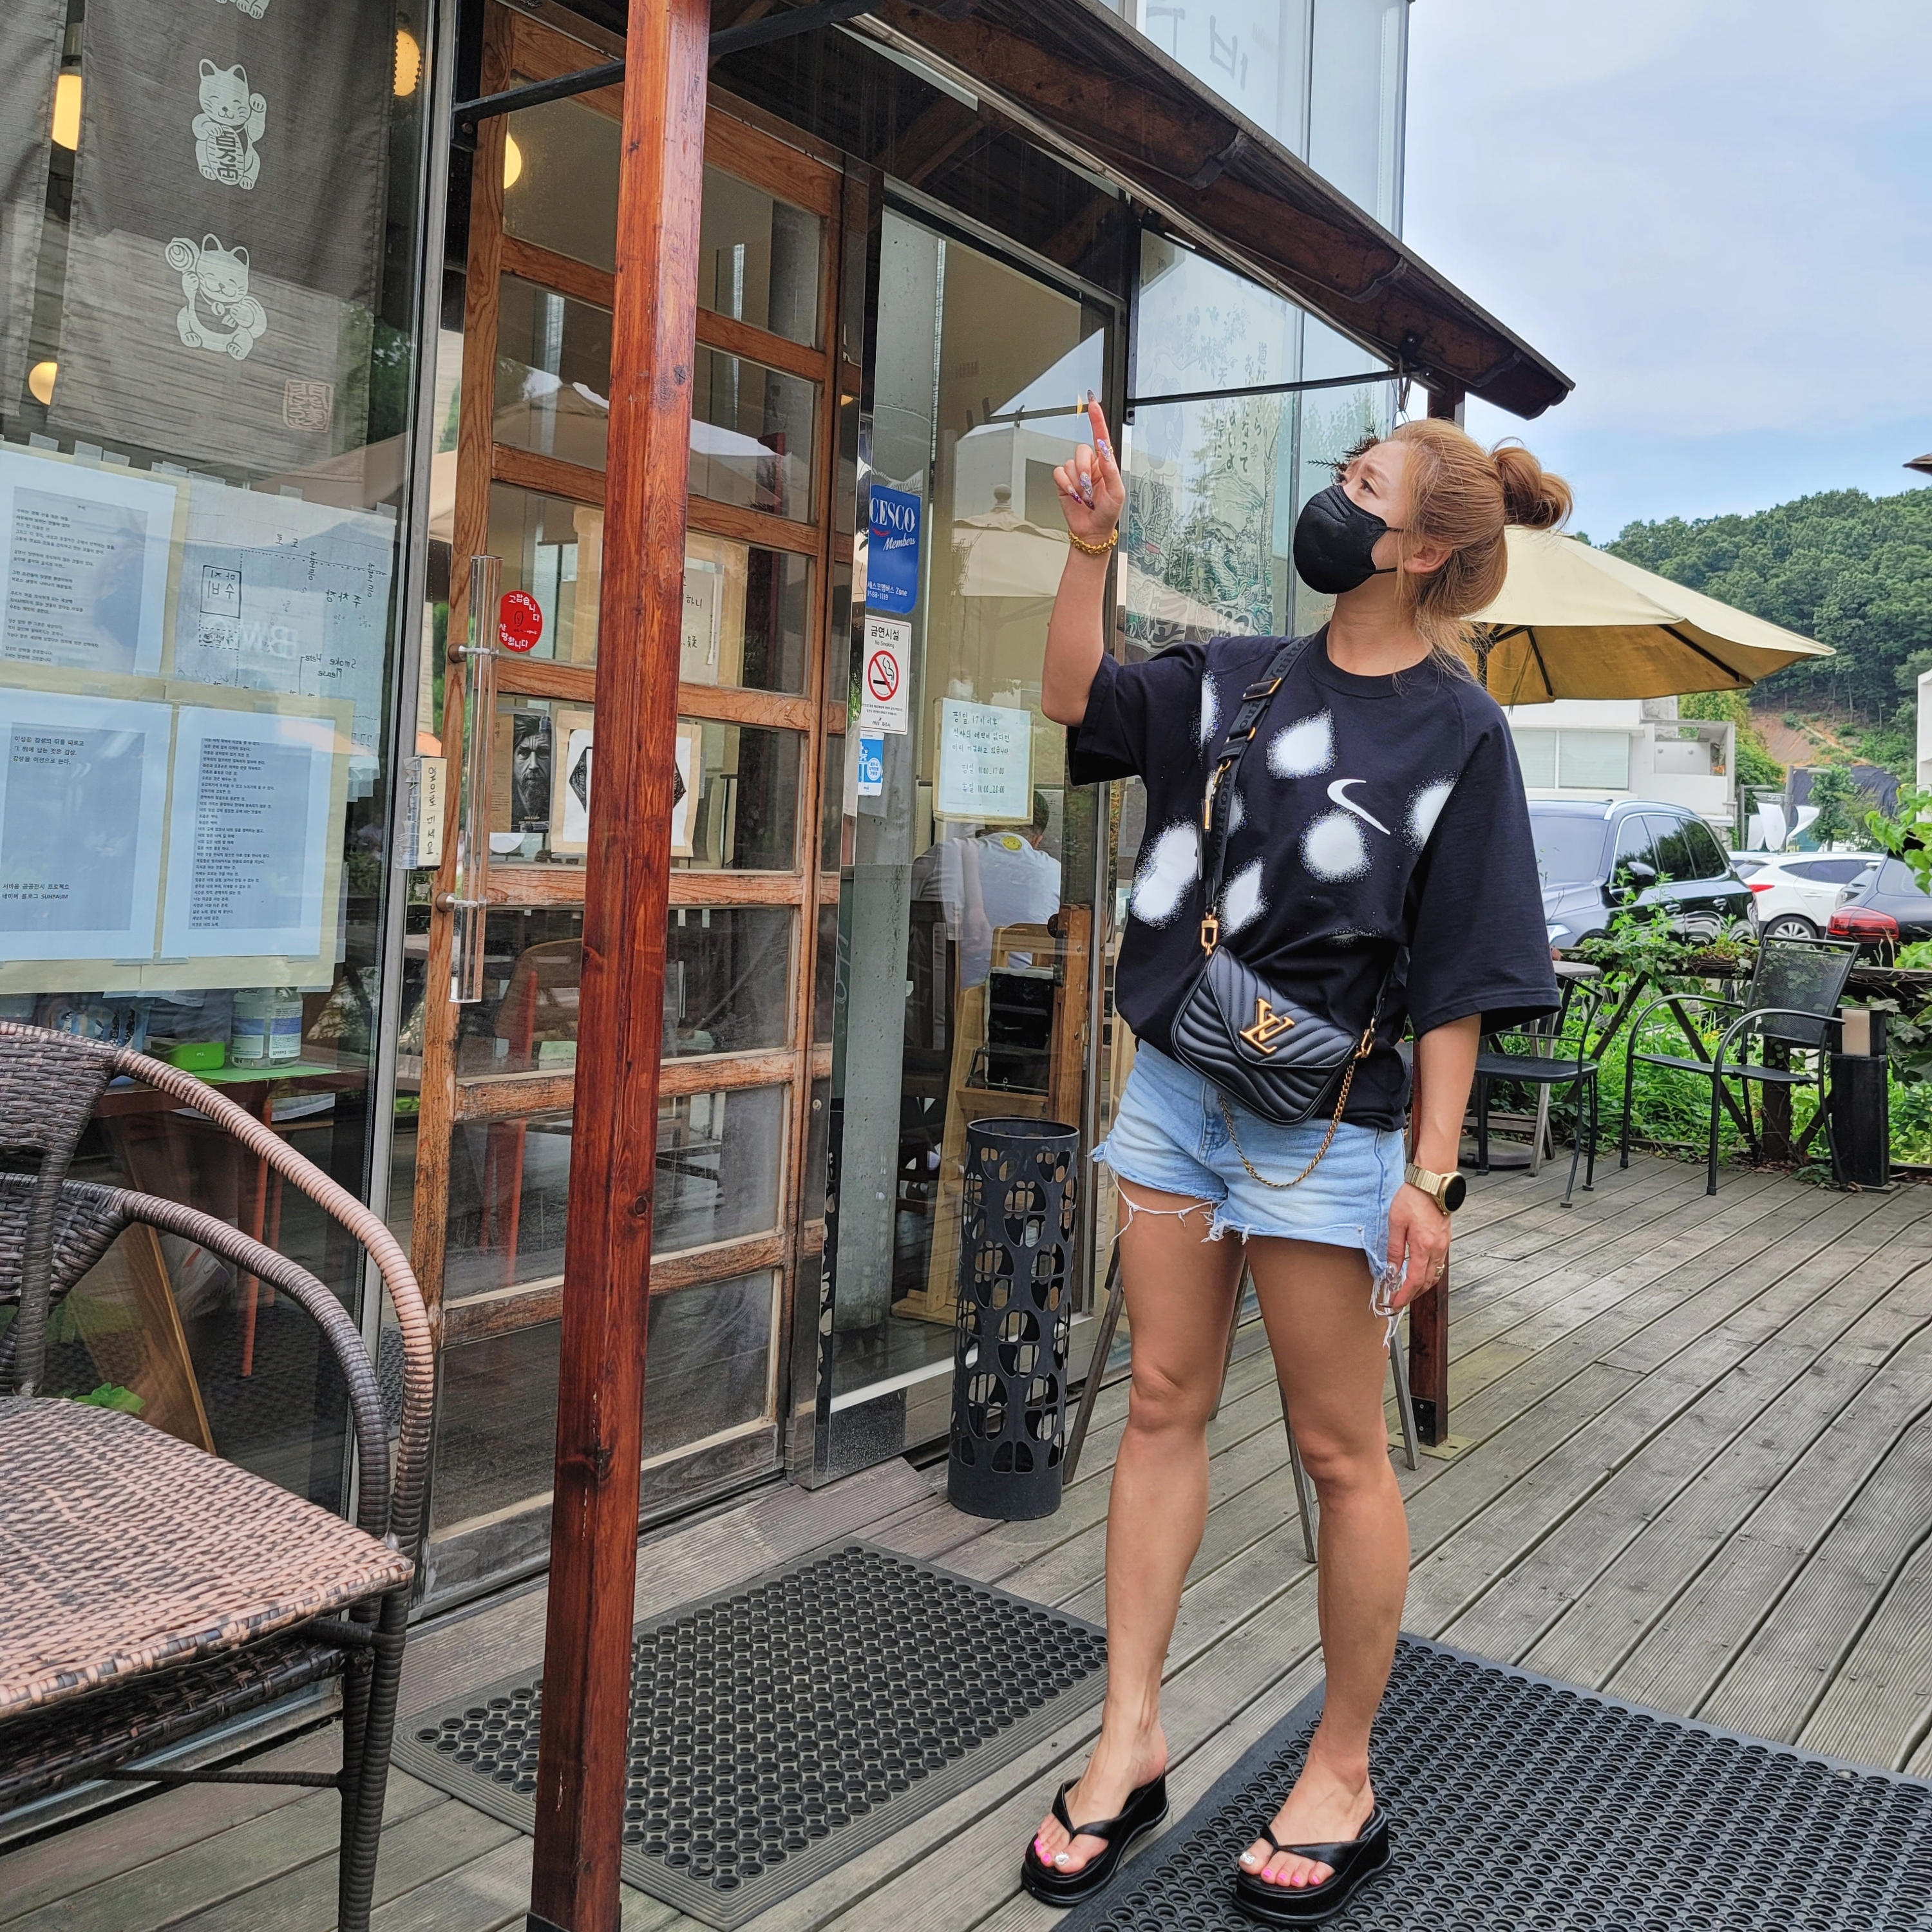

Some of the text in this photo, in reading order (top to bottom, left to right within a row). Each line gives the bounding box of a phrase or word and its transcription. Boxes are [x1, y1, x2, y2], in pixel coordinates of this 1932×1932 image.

[869, 497, 915, 533] CESCO
[882, 533, 915, 551] Members
[867, 581, 907, 597] 세스코멤버스 Zone
[867, 590, 888, 600] 1588-1119
[499, 623, 529, 649] 사랑합니다
[871, 625, 899, 641] 금연시설
[880, 641, 895, 649] Smoking
[952, 711, 967, 724] 평일
[972, 715, 984, 725] 17시
[953, 728, 971, 739] 식사의
[961, 763, 973, 774] 평일
